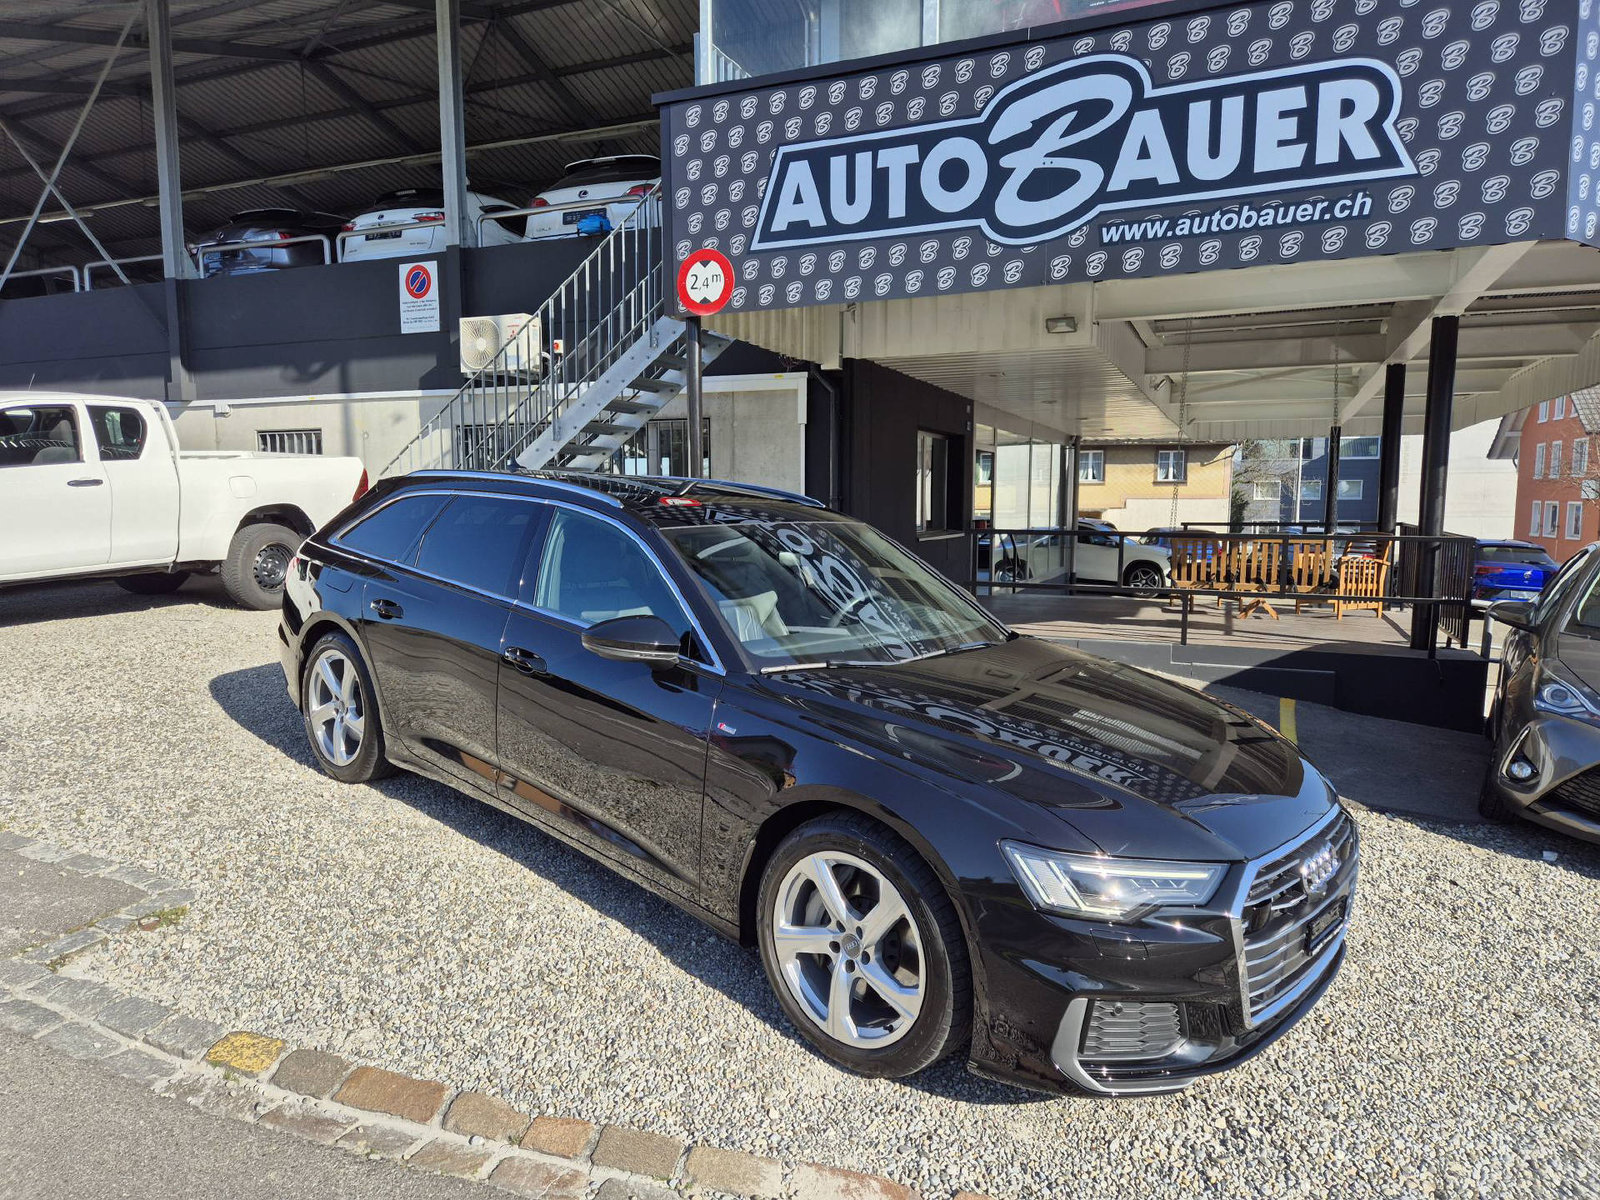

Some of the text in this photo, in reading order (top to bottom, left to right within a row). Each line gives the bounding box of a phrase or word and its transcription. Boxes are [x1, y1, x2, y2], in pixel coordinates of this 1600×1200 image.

[770, 74, 1381, 232] AUTO BAUER
[1101, 191, 1372, 243] www.autobauer.ch
